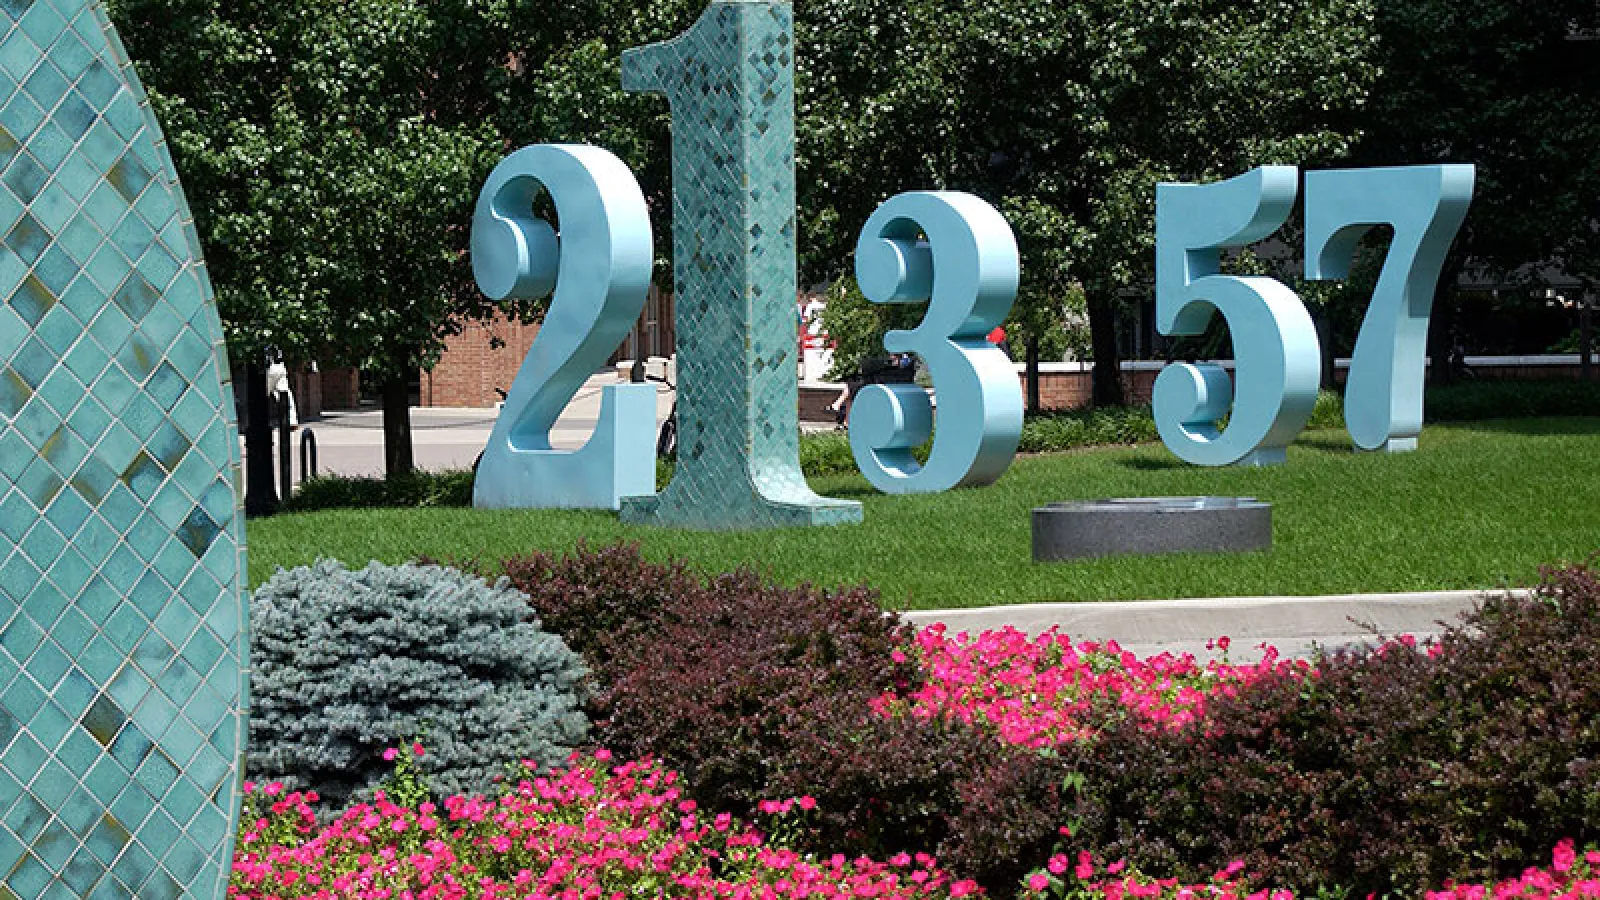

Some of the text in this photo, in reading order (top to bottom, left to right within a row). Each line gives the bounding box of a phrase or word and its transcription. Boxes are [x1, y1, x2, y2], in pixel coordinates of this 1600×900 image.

[470, 143, 656, 509] 2
[621, 1, 863, 529] 1
[849, 190, 1022, 493] 3
